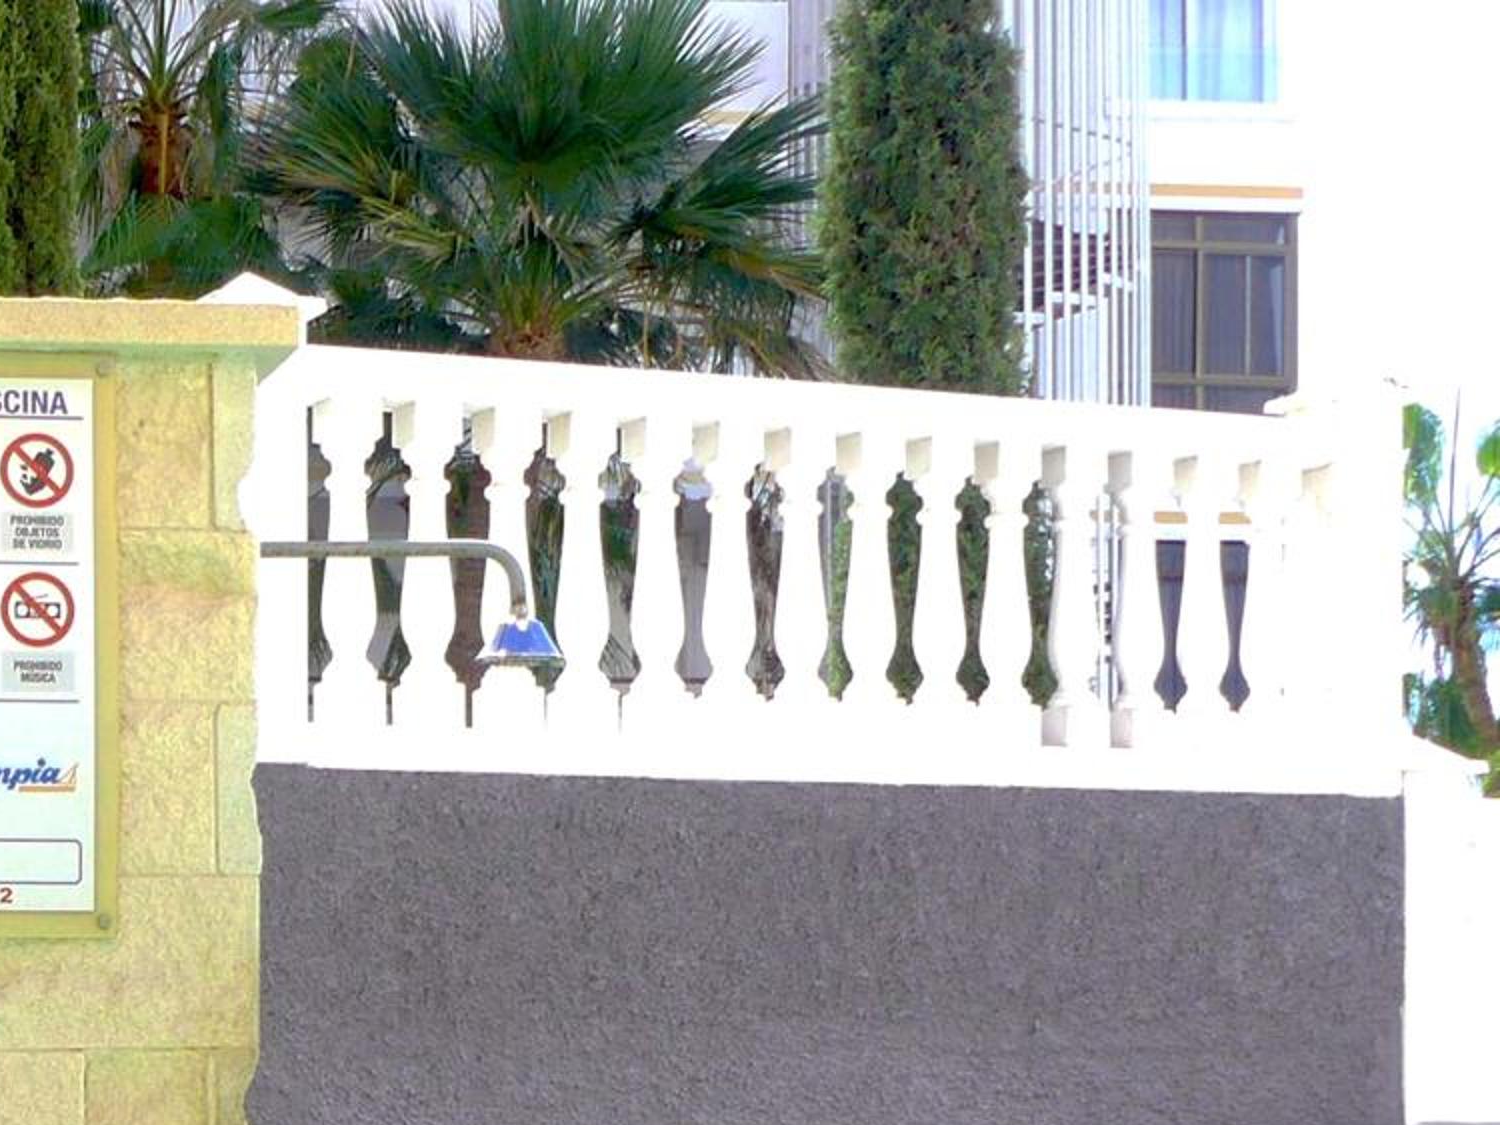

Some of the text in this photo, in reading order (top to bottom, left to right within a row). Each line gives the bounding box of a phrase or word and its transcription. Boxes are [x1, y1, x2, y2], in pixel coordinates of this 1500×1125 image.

[10, 516, 64, 526] PROHIBIDO
[15, 528, 59, 536] OBJETOS
[13, 539, 62, 549] DE VIDRIO
[14, 661, 63, 671] PROHIBIDO
